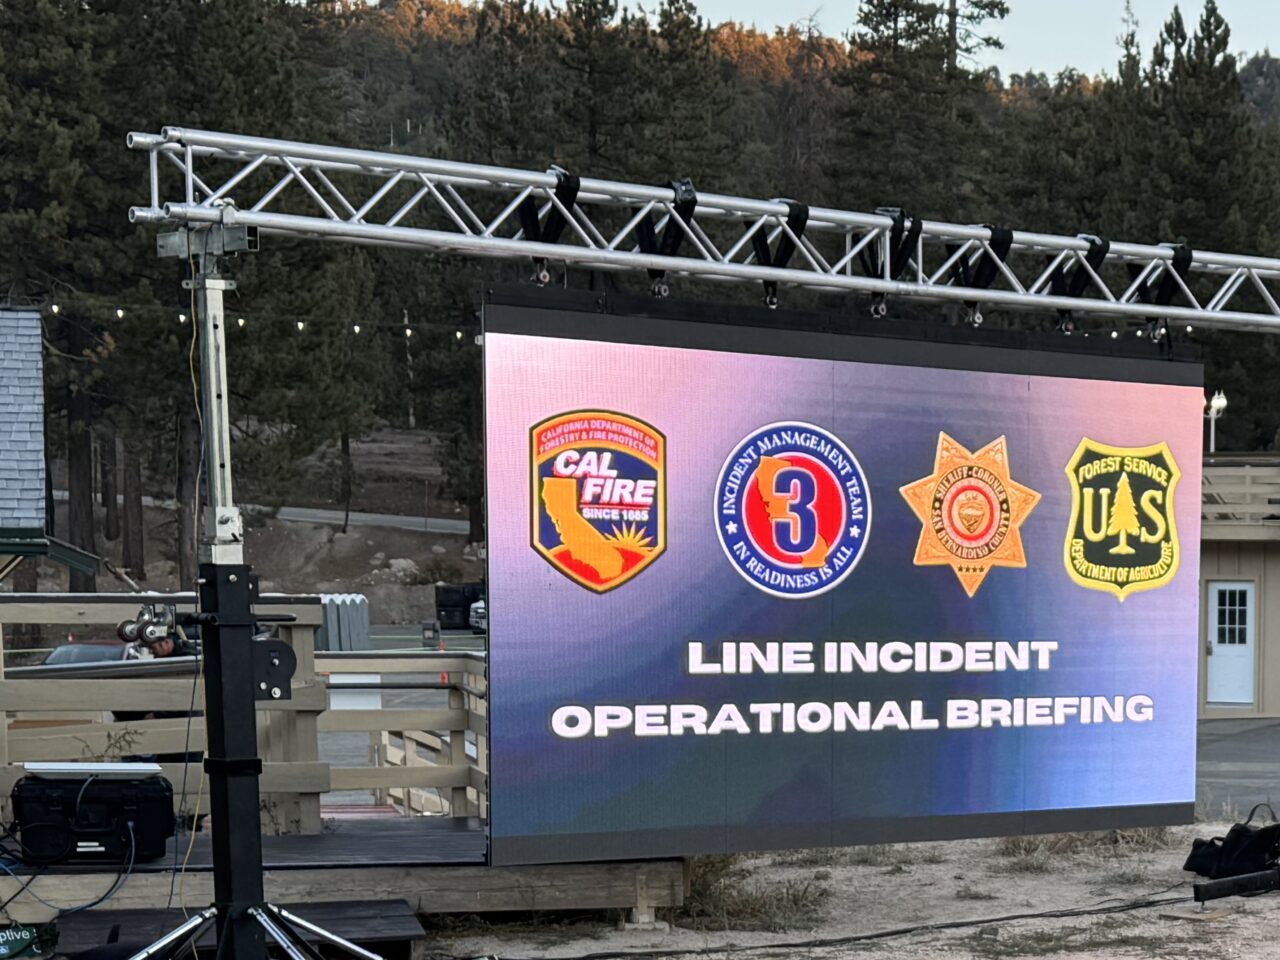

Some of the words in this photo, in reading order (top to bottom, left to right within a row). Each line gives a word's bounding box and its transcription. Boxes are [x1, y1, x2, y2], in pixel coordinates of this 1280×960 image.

[540, 431, 579, 453] FORESTRY
[589, 430, 607, 440] FIRE
[608, 432, 657, 459] PROTECTION
[541, 420, 590, 442] CALIFORNIA
[590, 419, 644, 441] DEPARTMENT
[643, 436, 656, 447] OF
[553, 449, 618, 477] CAL
[723, 445, 757, 515] INCIDENT
[756, 430, 852, 477] MANAGEMENT
[846, 475, 864, 520] TEAM
[1078, 456, 1122, 484] FOREST
[1123, 456, 1169, 487] SERVICE
[581, 477, 657, 505] FIRE
[582, 507, 620, 520] SINCE
[772, 466, 819, 555] 3
[1082, 487, 1111, 542] U
[1140, 489, 1167, 544] S
[733, 540, 750, 562] IN
[746, 556, 819, 590] READINESS
[819, 565, 834, 582] IS
[834, 545, 854, 572] ALL
[1072, 538, 1116, 581] DEPARTMENT
[1116, 566, 1128, 582] OF
[1128, 540, 1172, 582] AGRICULTURE
[688, 640, 814, 676] LINE
[824, 639, 1059, 674] INCIDENT
[551, 699, 939, 739] OPERATIONAL
[946, 694, 1155, 729] BRIEFING
